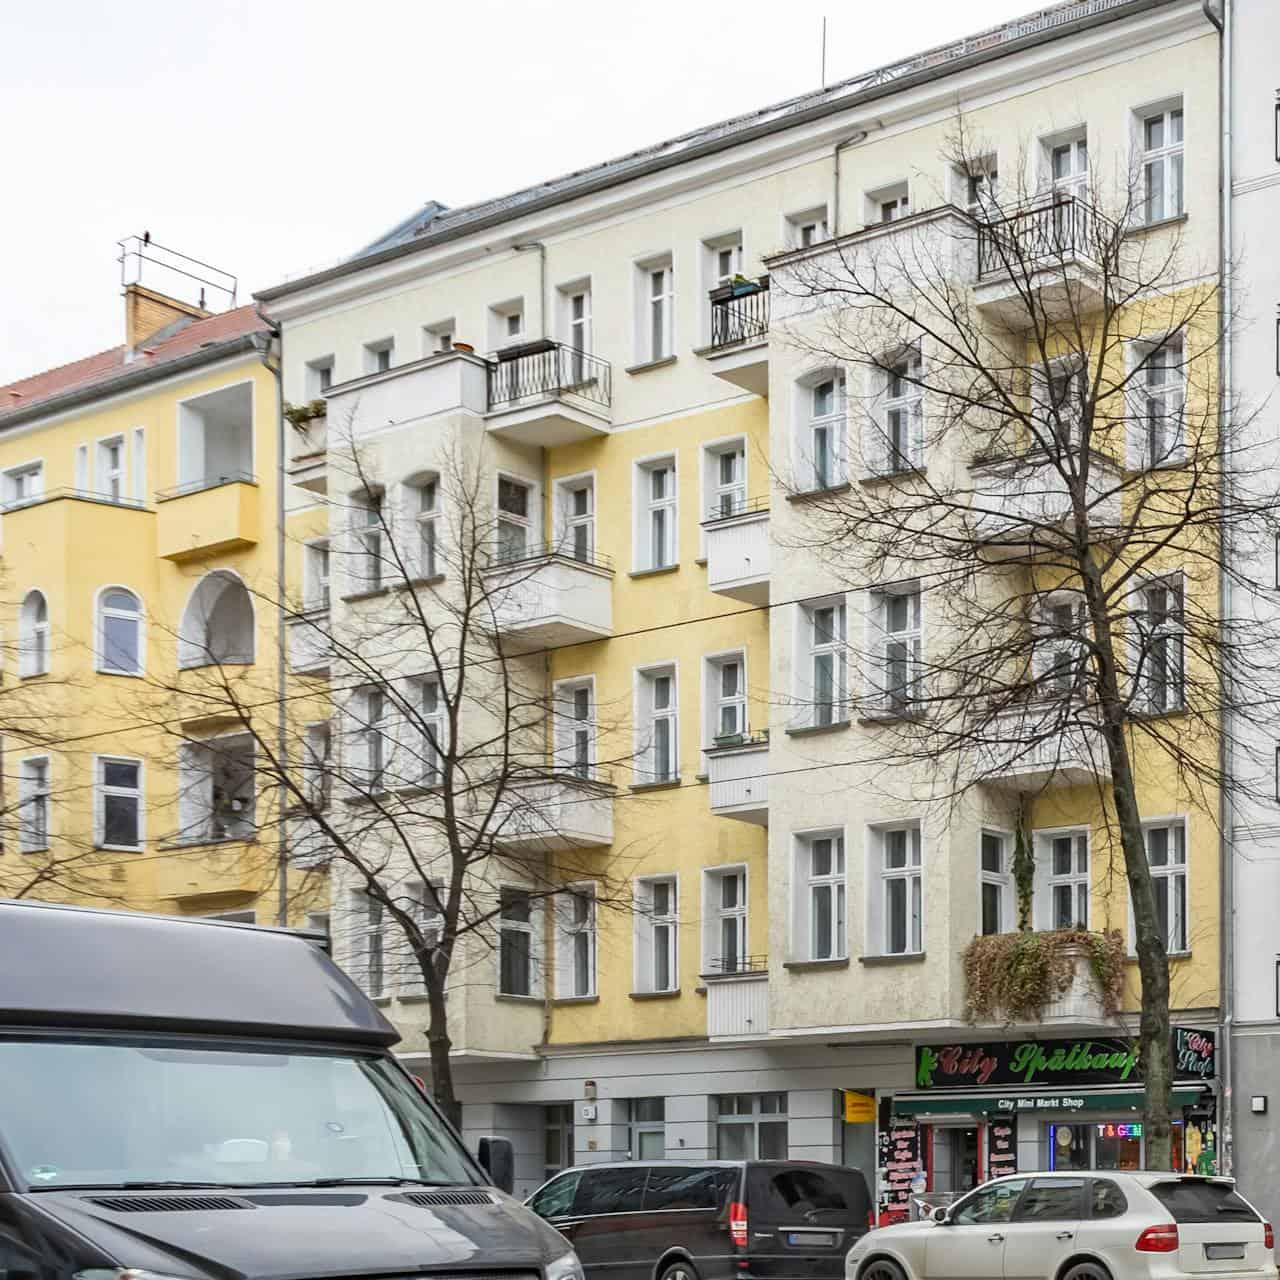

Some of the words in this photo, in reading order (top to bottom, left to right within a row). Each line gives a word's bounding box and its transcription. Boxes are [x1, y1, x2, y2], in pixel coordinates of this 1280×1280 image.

[998, 1099, 1015, 1112] City
[1017, 1098, 1034, 1108] Mini
[1036, 1098, 1060, 1108] Markt
[1062, 1097, 1084, 1109] Shop
